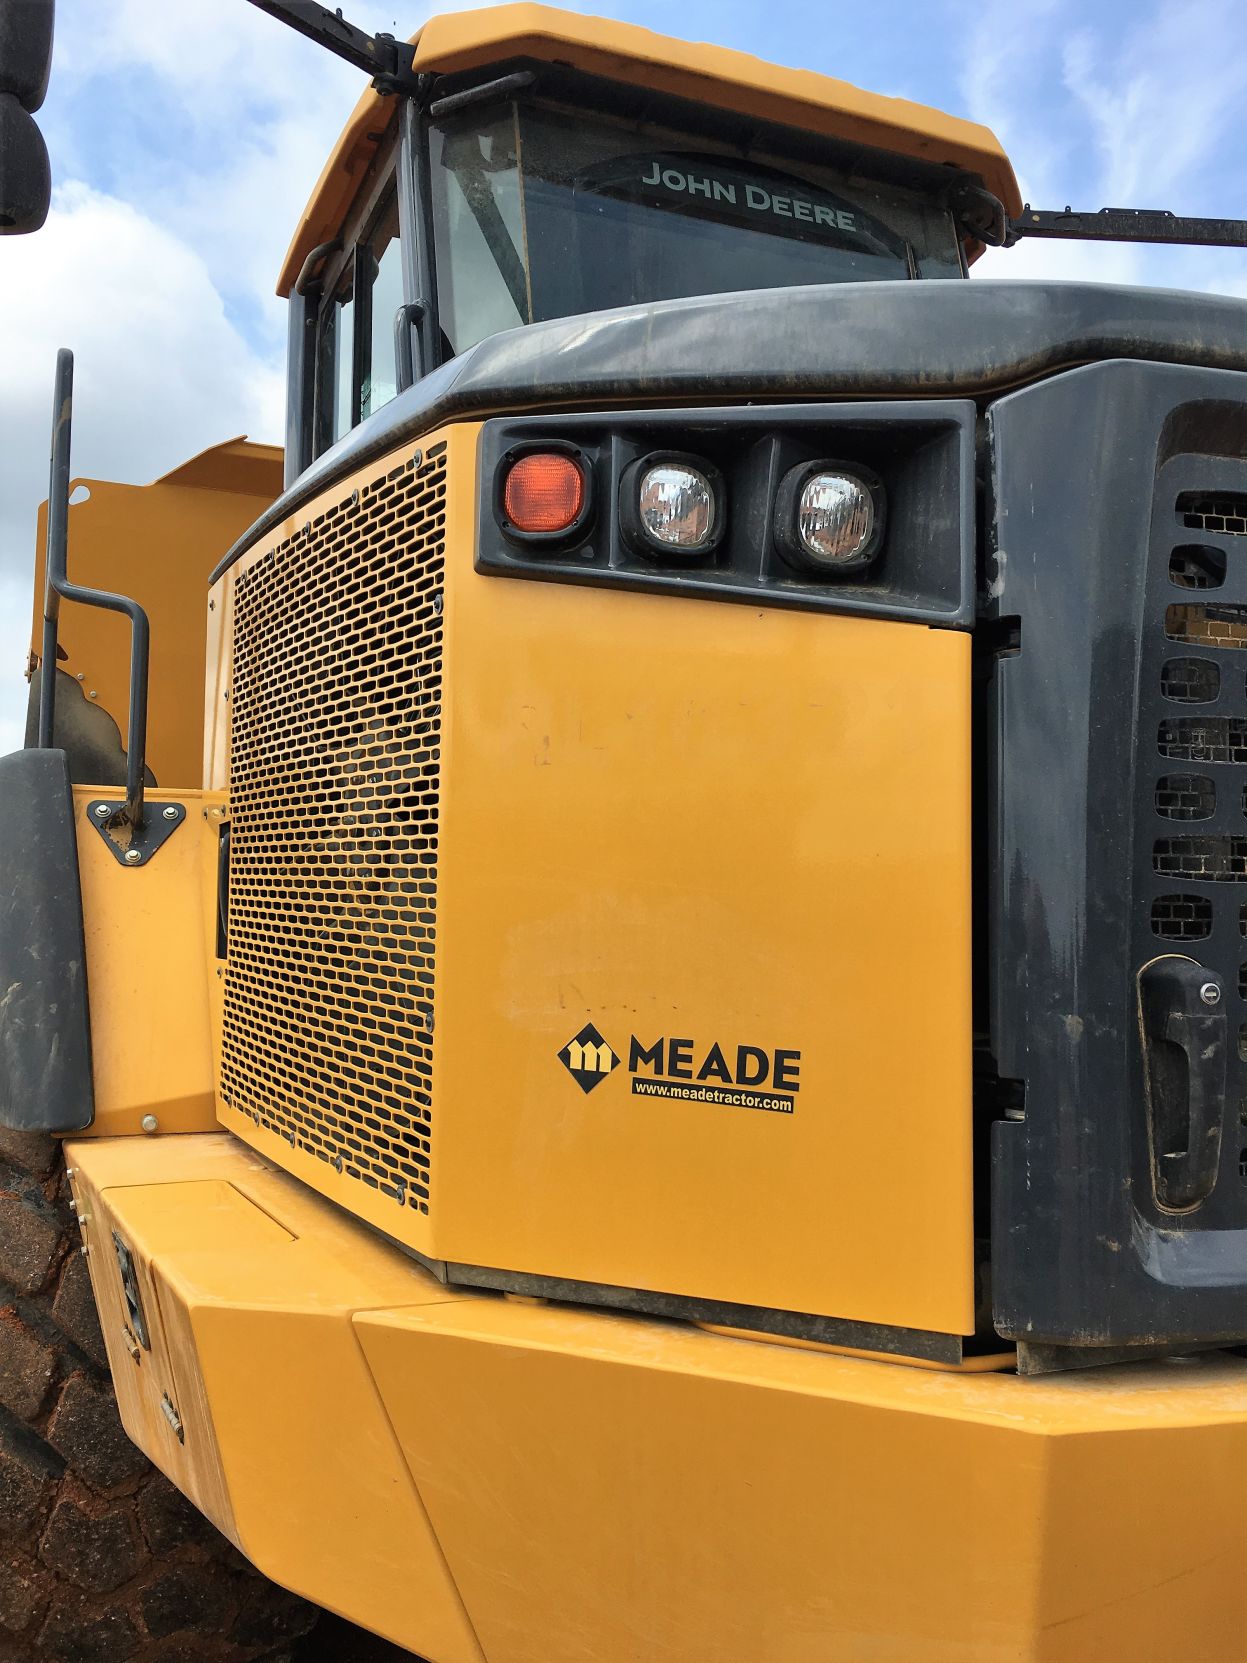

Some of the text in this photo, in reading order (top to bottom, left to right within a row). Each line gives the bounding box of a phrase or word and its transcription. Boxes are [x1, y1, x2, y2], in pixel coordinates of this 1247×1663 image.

[642, 162, 857, 232] JOHN DEERE
[628, 1034, 801, 1092] MEADE
[635, 1082, 792, 1112] www.meadetractor.com
